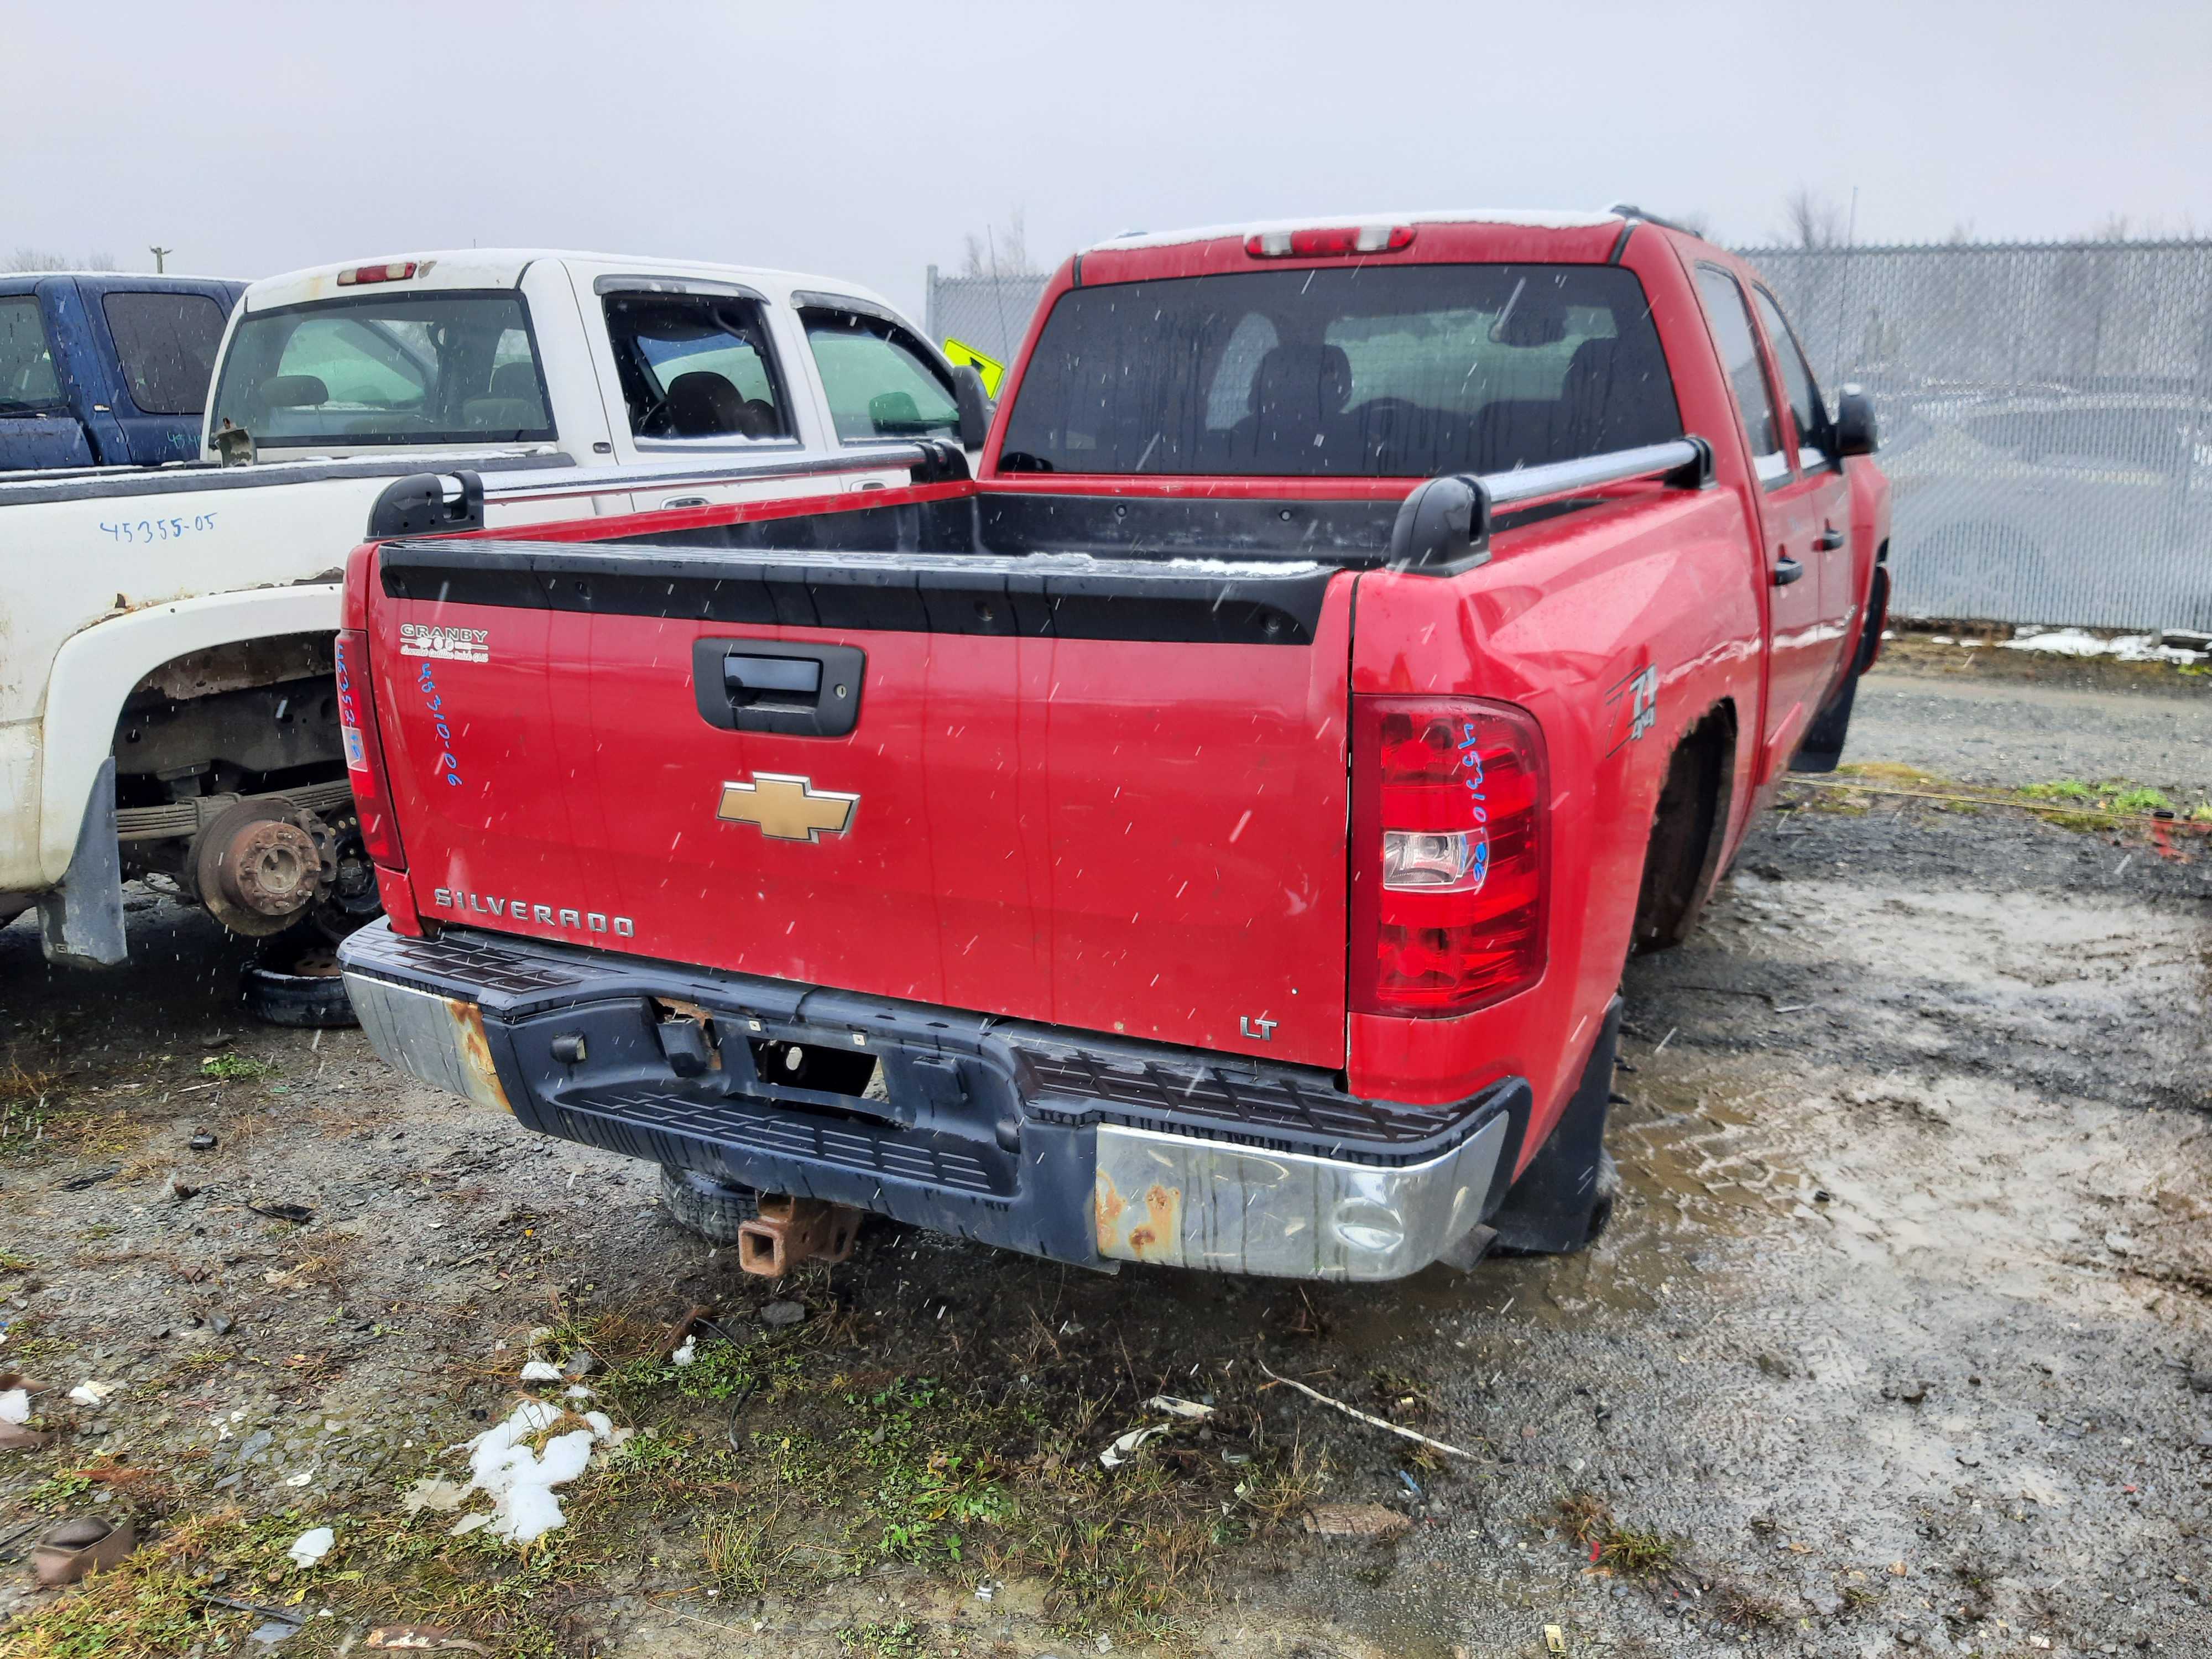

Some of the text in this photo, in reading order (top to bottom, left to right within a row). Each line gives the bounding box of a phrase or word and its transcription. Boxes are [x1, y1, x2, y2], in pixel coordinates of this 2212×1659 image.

[100, 513, 217, 543] 45355-05
[400, 624, 488, 643] GRANBY
[418, 663, 463, 786] 45310-06
[434, 888, 635, 938] SILVERADO
[1240, 1016, 1277, 1040] LT
